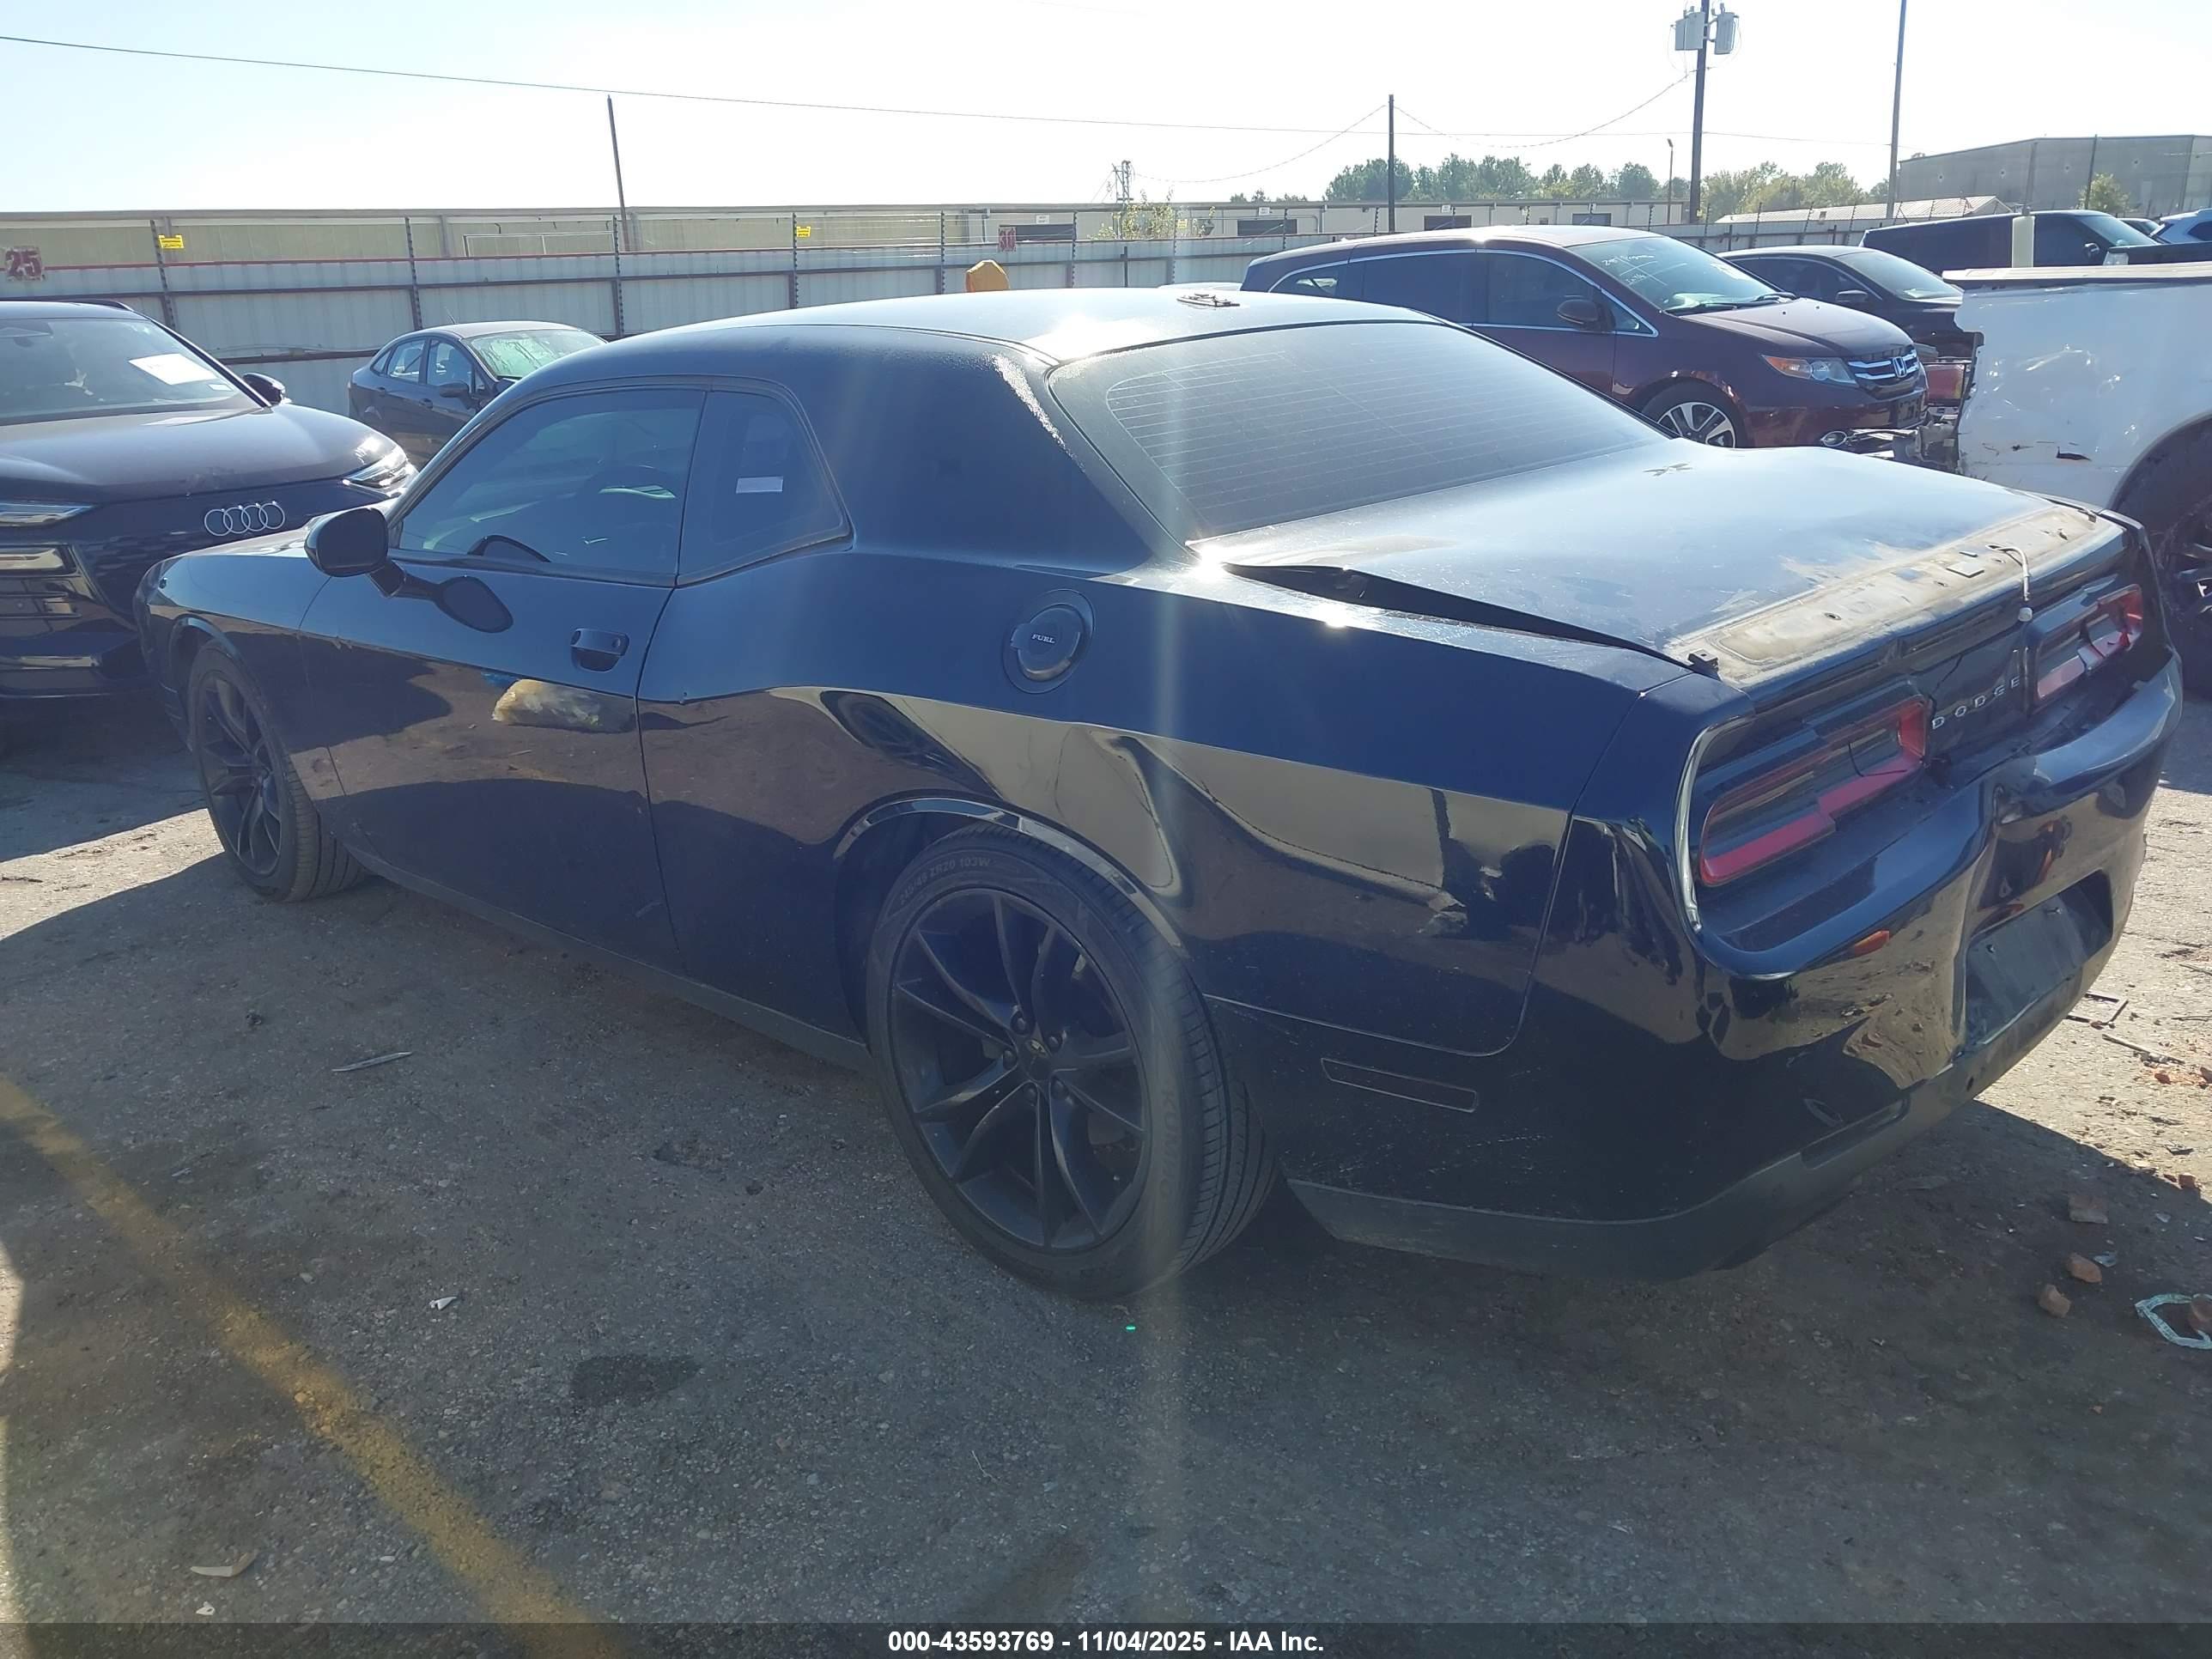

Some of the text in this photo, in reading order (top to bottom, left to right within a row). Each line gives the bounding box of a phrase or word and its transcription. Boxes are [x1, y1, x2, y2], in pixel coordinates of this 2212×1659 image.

[5, 246, 41, 277] 25
[1031, 634, 1055, 644] FUEL
[1931, 676, 2020, 730] DODGE
[929, 860, 956, 878] ZR20
[960, 857, 991, 869] 103W
[1159, 1087, 1180, 1200] KUMHO
